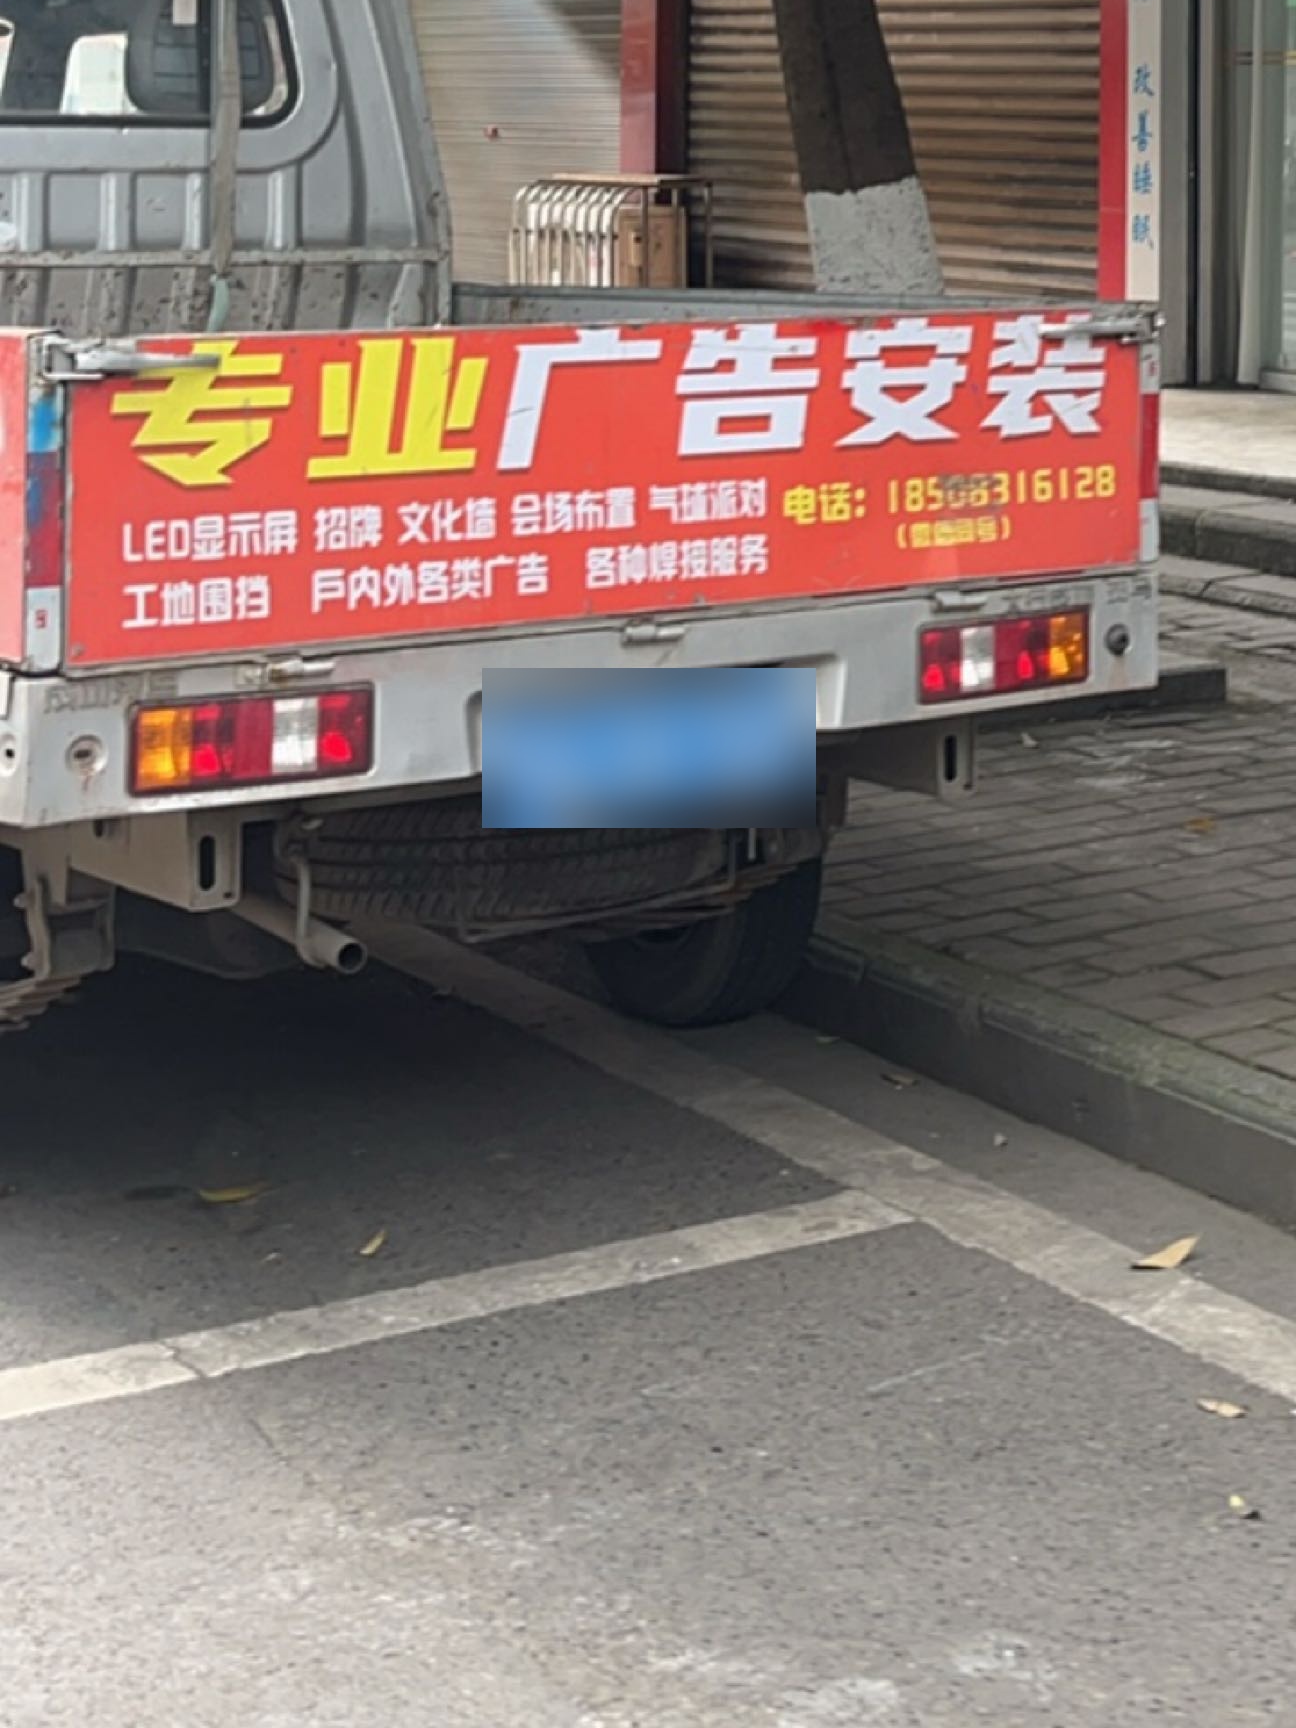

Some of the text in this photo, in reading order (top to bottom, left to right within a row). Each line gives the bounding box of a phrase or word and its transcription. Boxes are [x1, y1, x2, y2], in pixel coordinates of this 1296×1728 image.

[110, 314, 1110, 490] 专业广告安装
[122, 476, 768, 562] LED显示屏 招牌 文化墙 会场布置 气球派对
[121, 574, 271, 630] 工地围挡
[584, 532, 770, 590] 各种焊接服务
